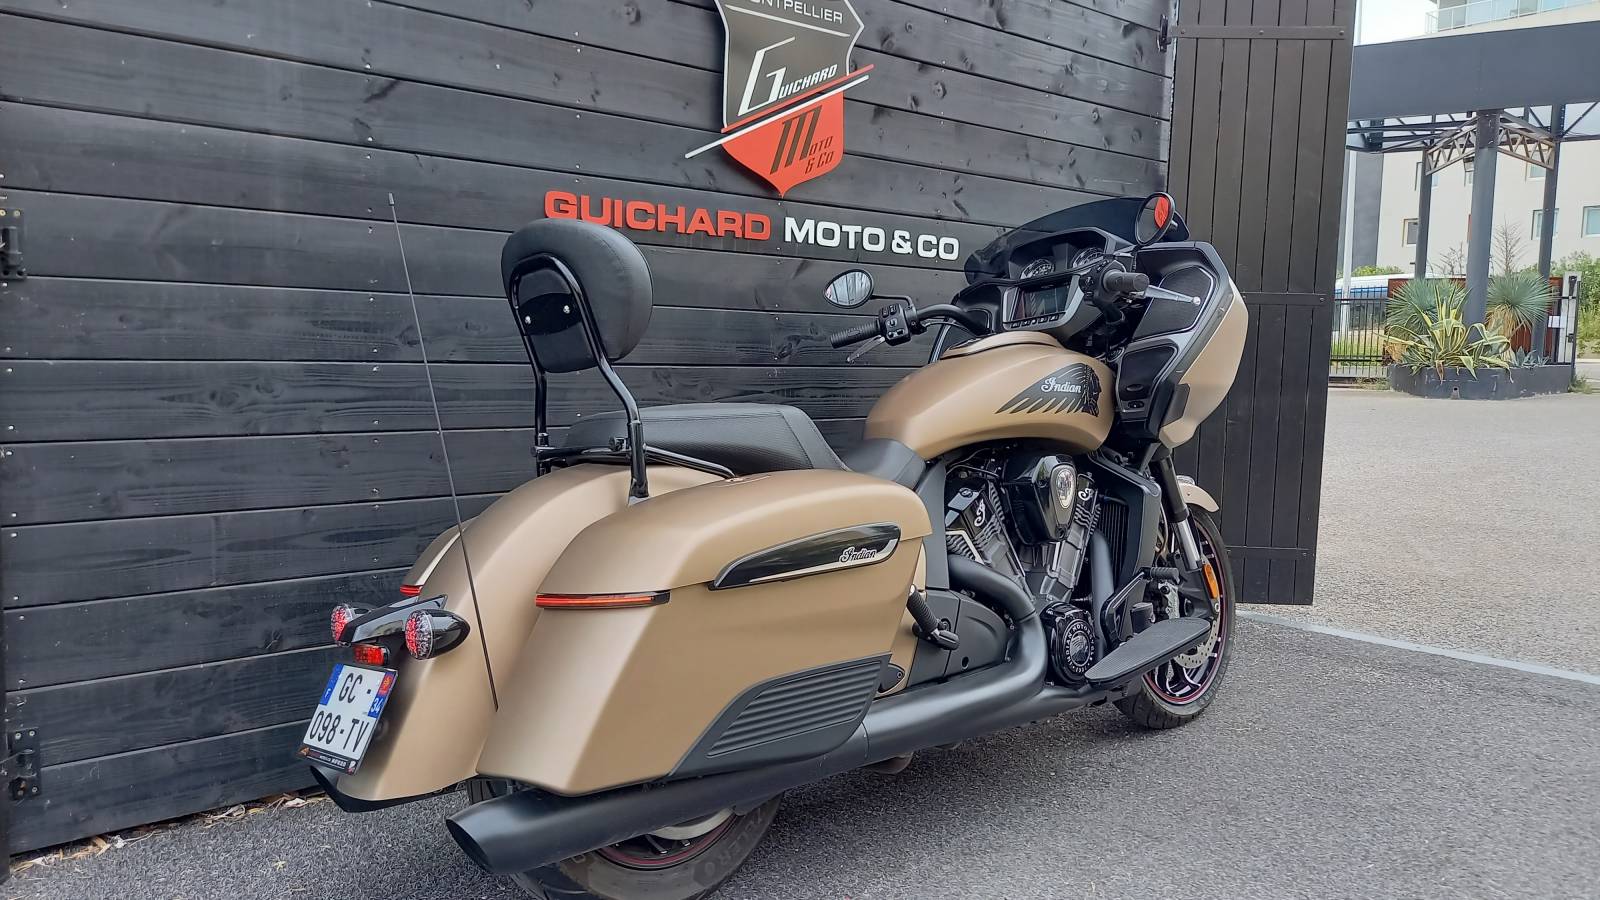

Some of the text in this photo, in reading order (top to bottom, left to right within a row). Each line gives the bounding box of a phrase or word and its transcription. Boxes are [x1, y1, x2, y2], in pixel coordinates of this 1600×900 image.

[738, 36, 838, 116] GUICHARD
[544, 190, 960, 261] GUICHARD MOTO & CO
[1040, 377, 1082, 394] Indian
[839, 546, 878, 563] Indian
[309, 710, 370, 753] 098-TV
